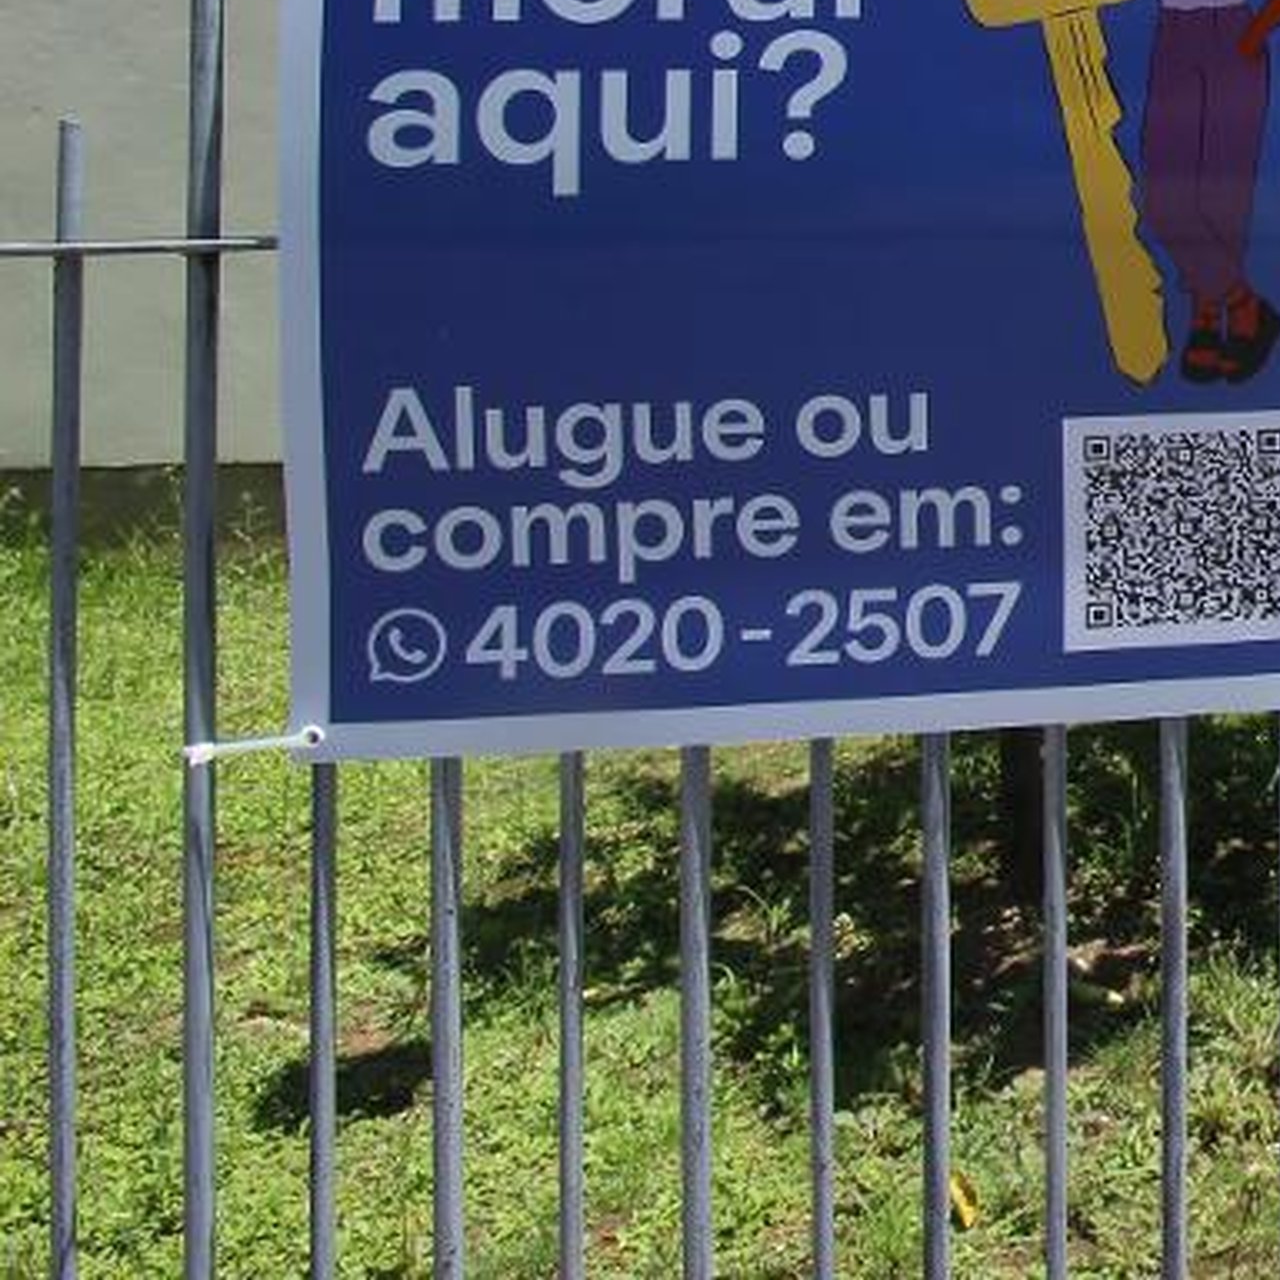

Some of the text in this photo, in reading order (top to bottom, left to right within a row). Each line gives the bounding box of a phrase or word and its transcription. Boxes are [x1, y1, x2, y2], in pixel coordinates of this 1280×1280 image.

[366, 29, 849, 197] aqui?
[361, 385, 930, 489] Alugue ou
[361, 484, 1024, 584] compre em:
[464, 581, 1023, 680] 4020-2507
